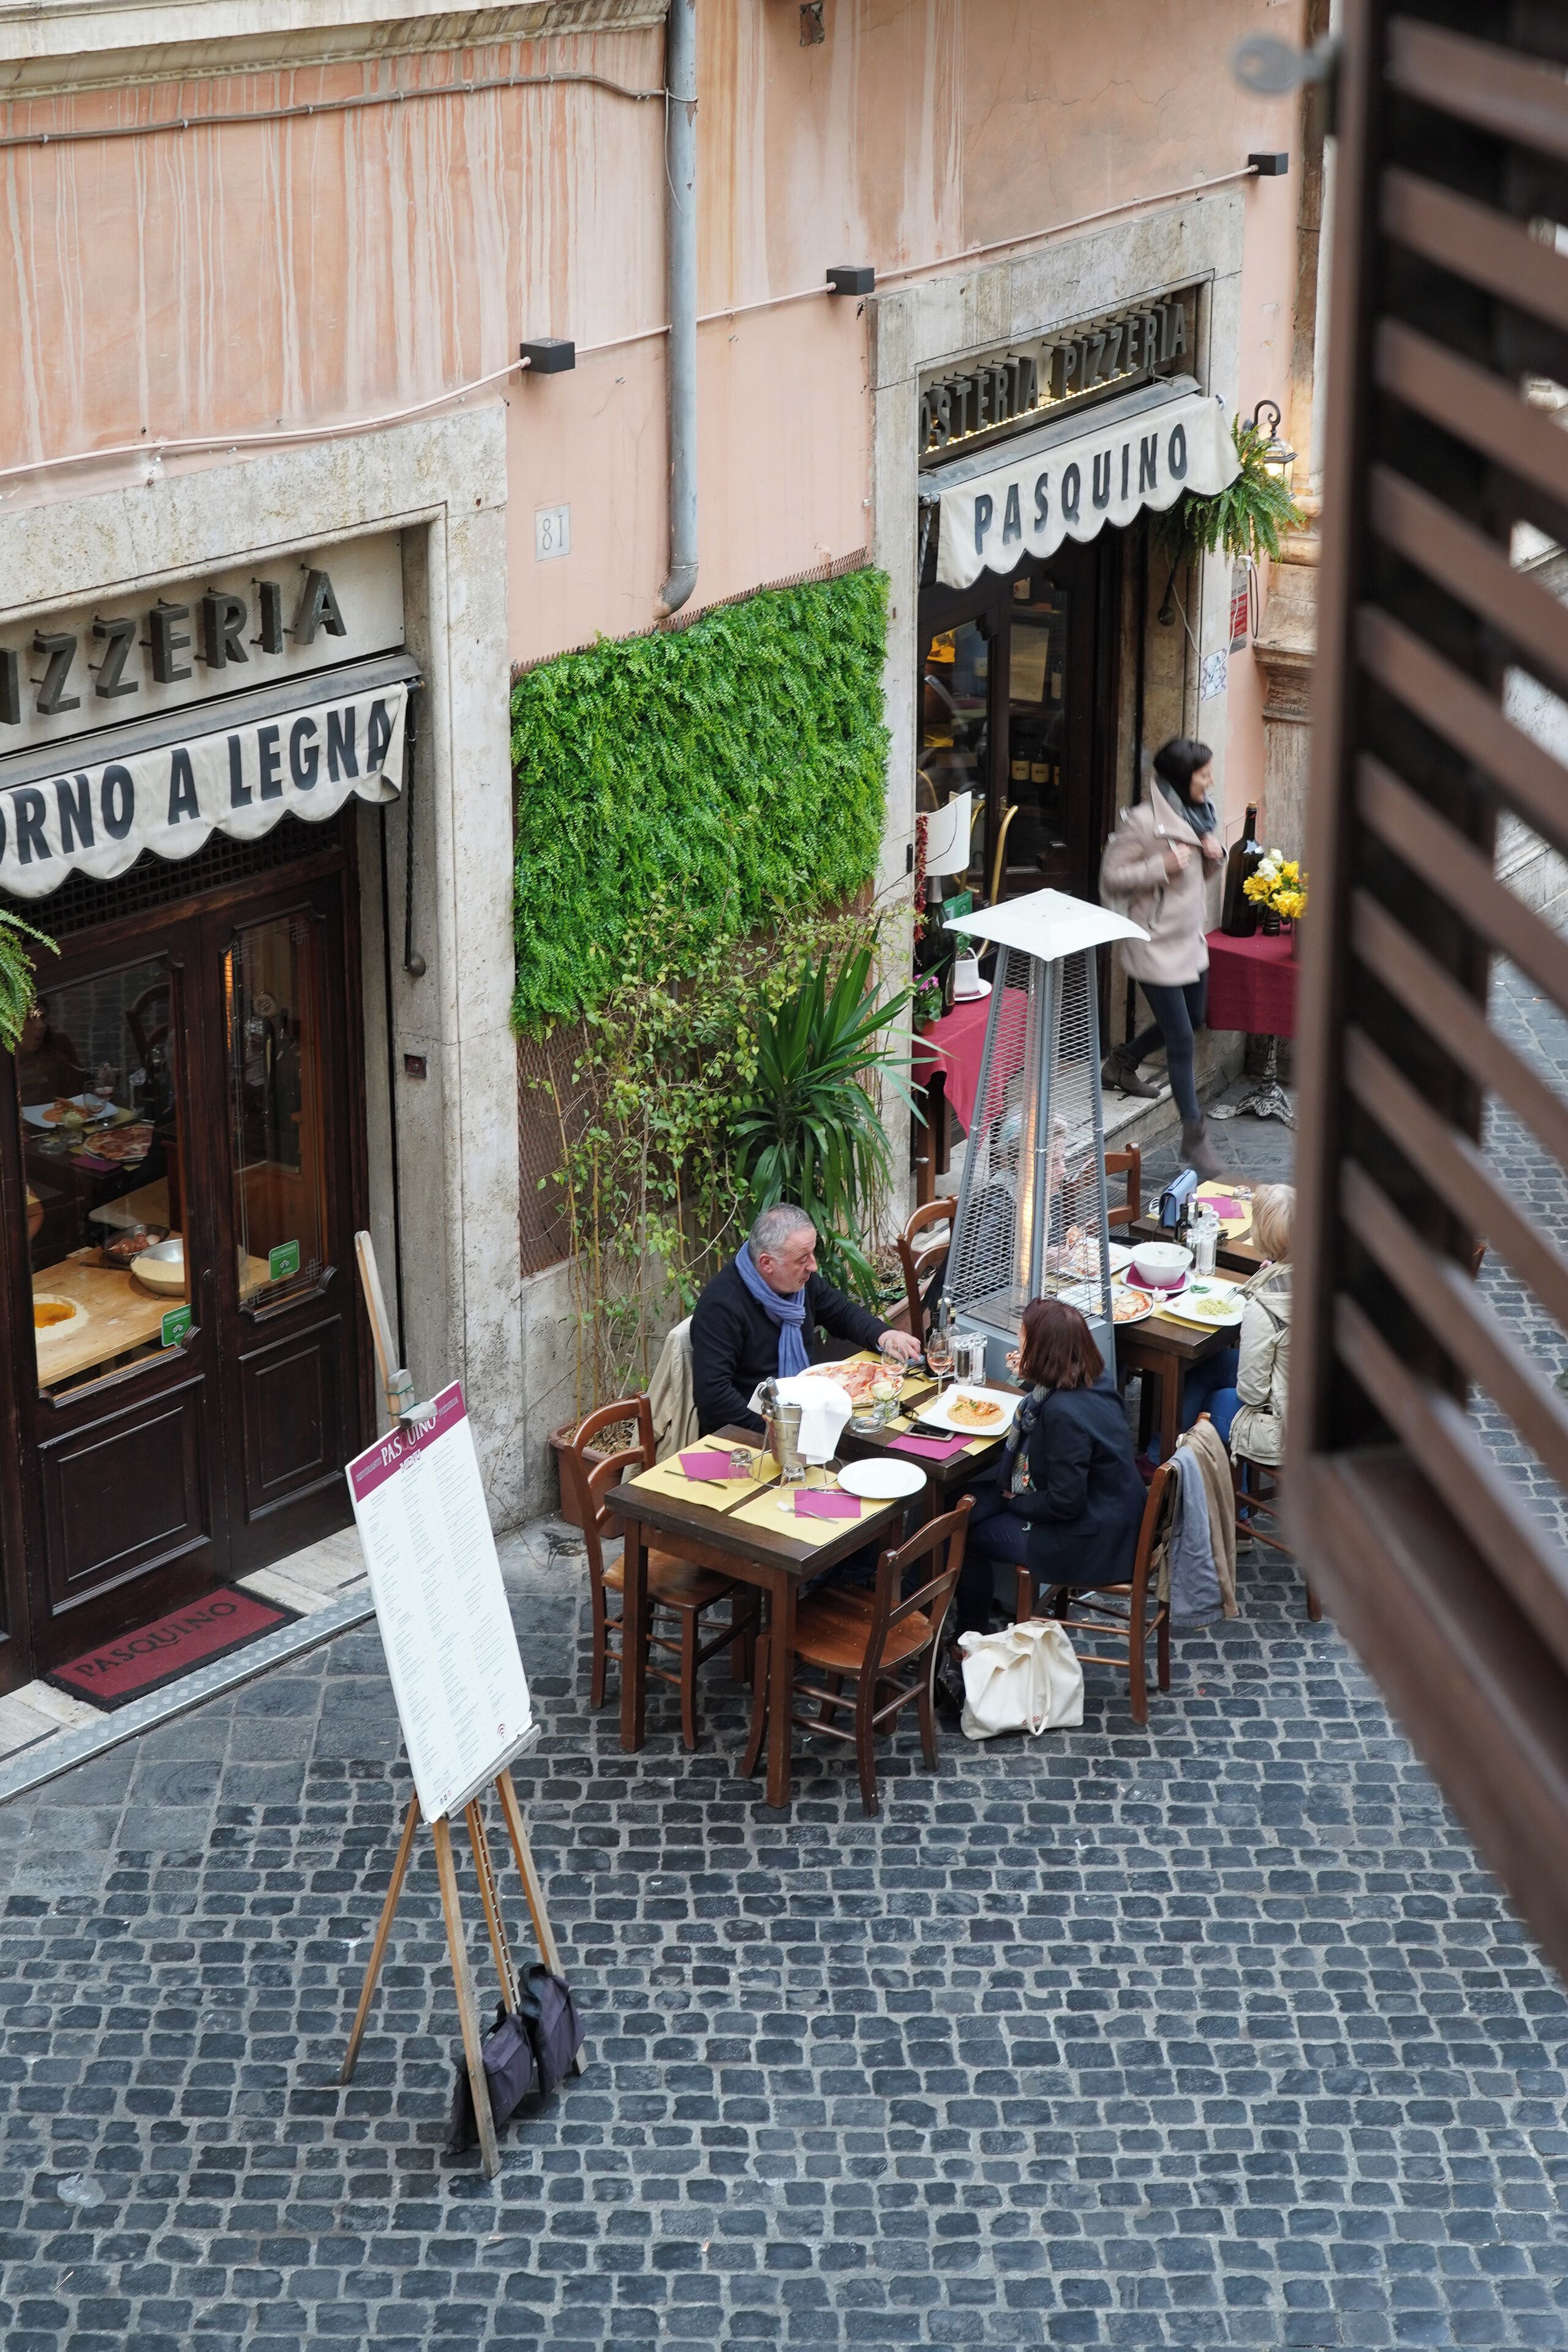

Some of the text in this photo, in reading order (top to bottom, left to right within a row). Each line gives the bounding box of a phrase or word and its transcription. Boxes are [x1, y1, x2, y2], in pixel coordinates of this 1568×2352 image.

[1053, 304, 1187, 399] PIZZERIA
[542, 514, 564, 551] 81
[974, 423, 1187, 556] PASQUINO
[0, 569, 347, 724] IZZERIA
[0, 699, 391, 865] RNO A LEGNA
[74, 1601, 237, 1678] PASQUINO
